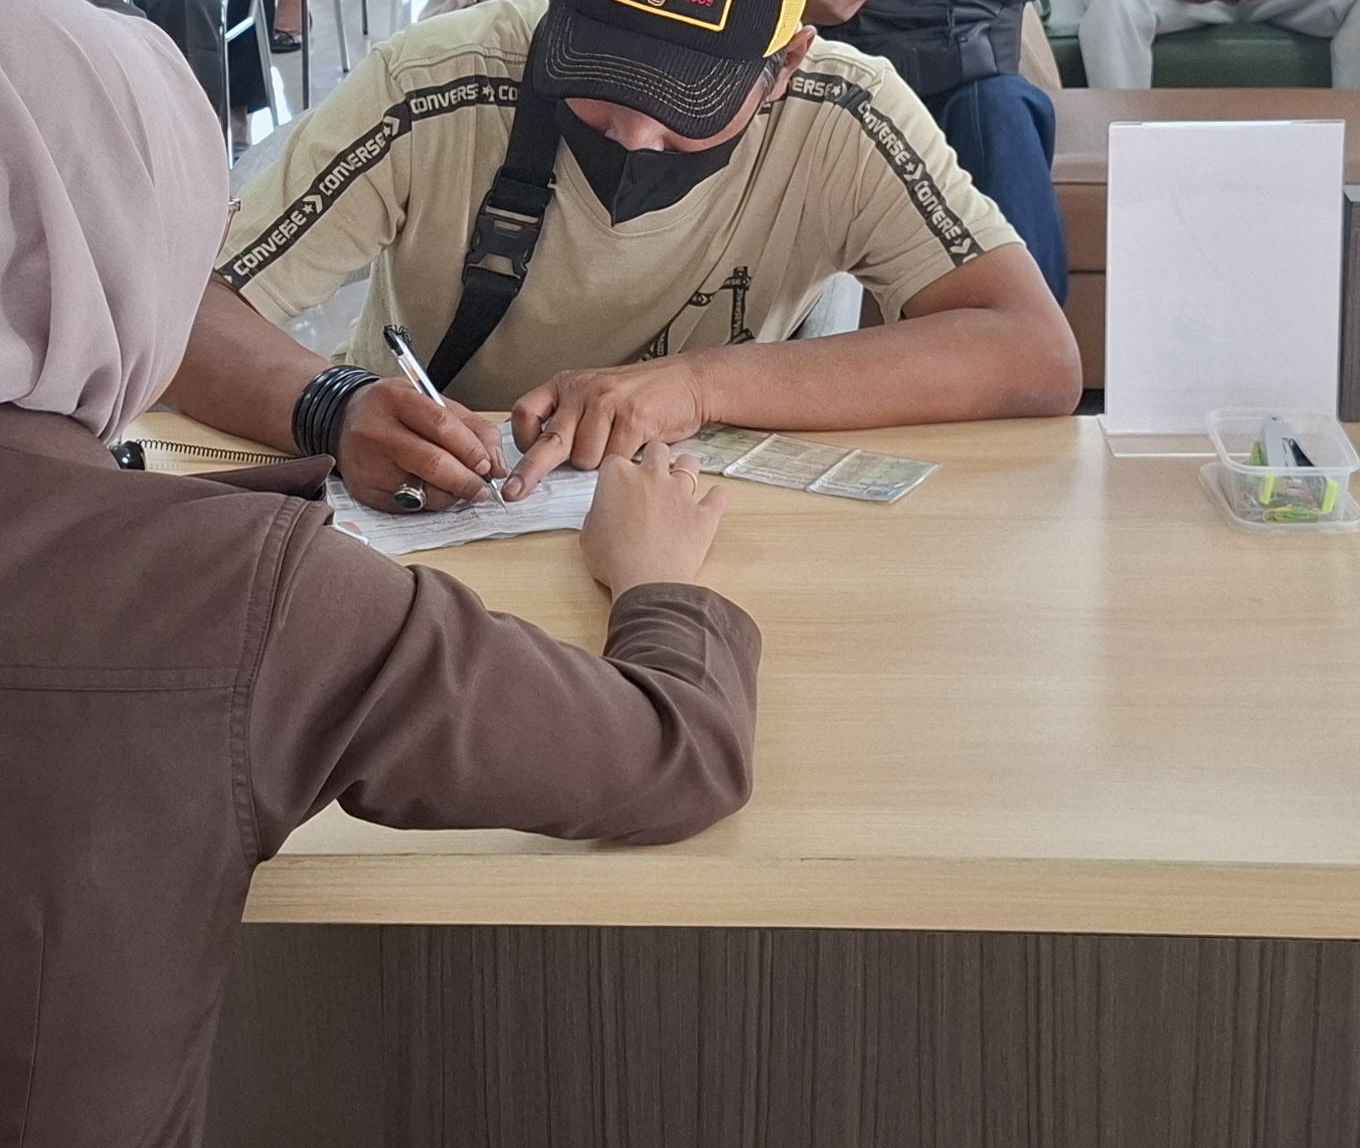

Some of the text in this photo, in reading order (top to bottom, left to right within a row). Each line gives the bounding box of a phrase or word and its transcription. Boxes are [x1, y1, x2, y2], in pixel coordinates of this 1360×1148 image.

[791, 77, 833, 98] ERSE
[318, 131, 387, 197] CONVERSE
[232, 210, 308, 277] CONVERSE
